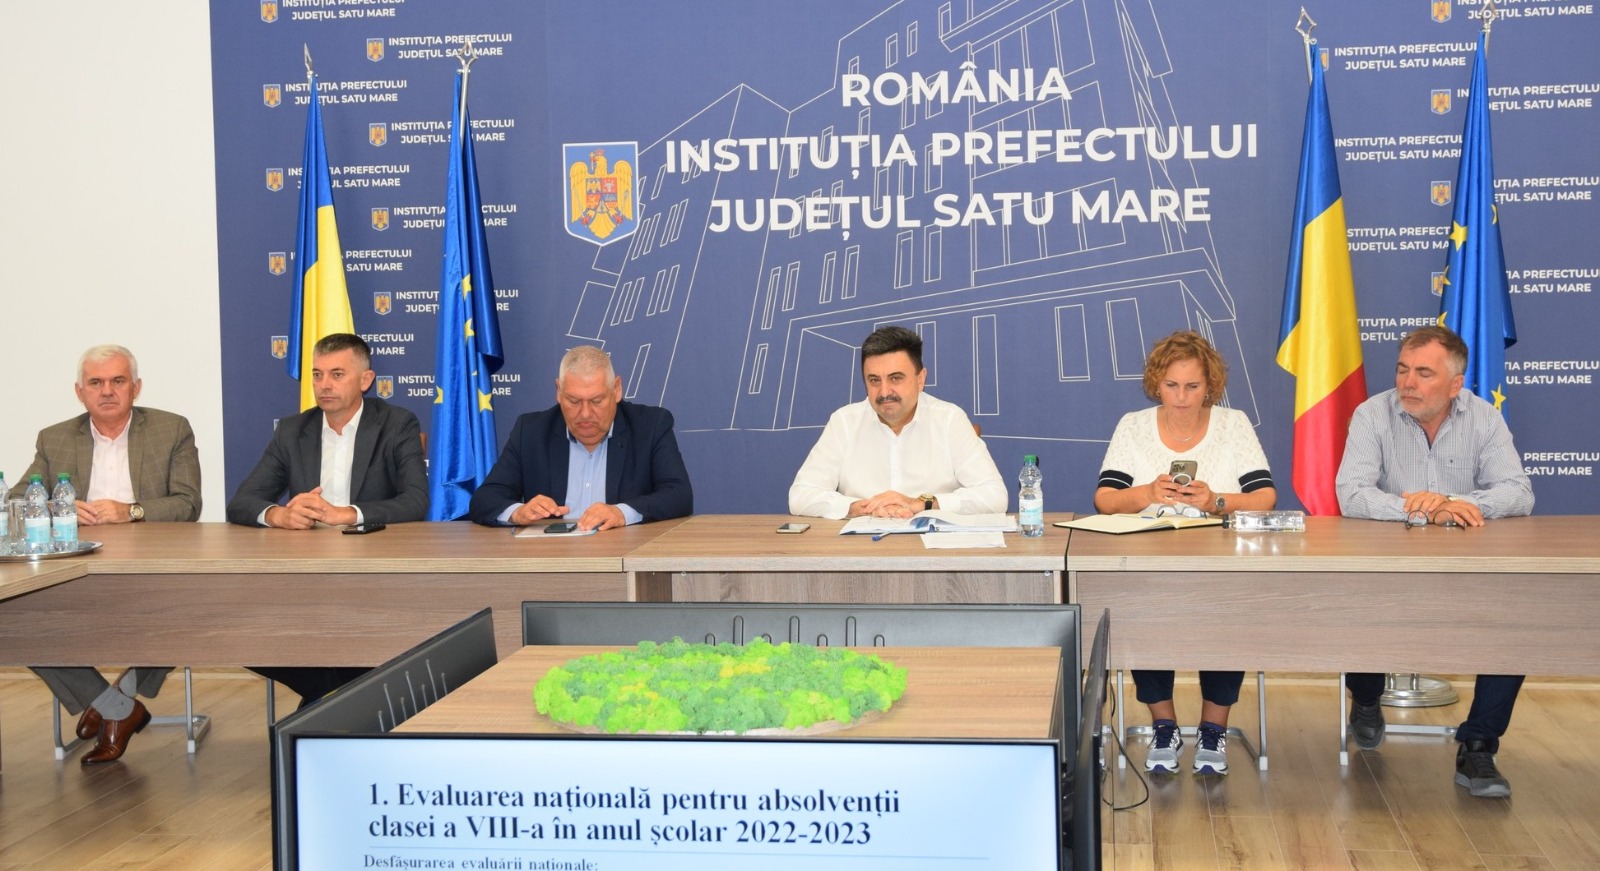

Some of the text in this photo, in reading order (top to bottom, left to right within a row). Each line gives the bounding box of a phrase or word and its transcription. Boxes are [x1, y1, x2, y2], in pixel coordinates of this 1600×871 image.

[292, 8, 395, 21] JUDEȚUL SATU MARE
[1524, 7, 1554, 16] SATU
[1558, 5, 1593, 15] MARE
[388, 33, 512, 47] INSTITUȚIA PREFECTULUI
[398, 49, 443, 60] JUDEȚUL
[1334, 42, 1477, 57] INSTITUȚIA PREFECTULUI
[1345, 57, 1466, 71] JUDEȚUL SATU MARE
[285, 80, 407, 93] INSTIUȚIA PREFECTULUI
[841, 61, 1072, 107] ROMÂNIA
[1457, 83, 1600, 98] INTUȚIA PREFECTULU
[341, 94, 367, 103] SATU
[369, 93, 398, 102] MARE
[1489, 98, 1592, 113] EȚUL SATU MARE
[391, 121, 445, 132] INSTITUȚIA
[400, 135, 446, 145] JUDEȚUL
[476, 133, 505, 142] MARE
[1334, 134, 1463, 148] INSTITUȚIA PREFECTUL
[666, 123, 1257, 180] INSTITUȚIA PREFECTULUI
[1345, 151, 1397, 162] JUDEȚUL
[1399, 150, 1429, 160] SATU
[343, 165, 410, 175] PREFECTULUI
[344, 179, 369, 188] SATU
[372, 178, 400, 187] MARE
[1523, 176, 1600, 188] PREFECTULU
[1523, 192, 1554, 202] SATU
[1557, 191, 1592, 200] MARE
[393, 204, 517, 217] INSTITUȚIA CTULUI
[709, 187, 1211, 241] JUDEȚUL SATU MARE
[1346, 226, 1450, 239] STITUȚIA PREFECT
[1347, 240, 1449, 253] JUDEȚUL SATU MA
[345, 249, 412, 259] PREFECTULUI
[346, 262, 403, 272] SATU MARE
[1523, 284, 1554, 293] SATU
[1557, 283, 1591, 292] MARE
[396, 290, 439, 301] INSTITUȚ
[405, 304, 439, 314] JUDEȚ
[357, 333, 414, 342] EFECTULUI
[1361, 332, 1398, 343] DEȚUL
[376, 347, 405, 355] MARE
[1523, 360, 1600, 370] PREFECTULU
[398, 375, 435, 384] INSTITU
[1524, 375, 1554, 385] SATU
[1557, 374, 1592, 384] MARE
[407, 387, 511, 397] JUDE ARE
[1524, 452, 1600, 461] PREFECTULU
[1524, 466, 1592, 476] SATU MARE
[369, 783, 900, 818] 1. Evaluarea națională pentru absolvenții
[369, 815, 872, 846] clasei a VIII-a în anul școlar 2022-2023
[364, 854, 455, 870] Desfășurarea
[461, 855, 522, 870] evaluării
